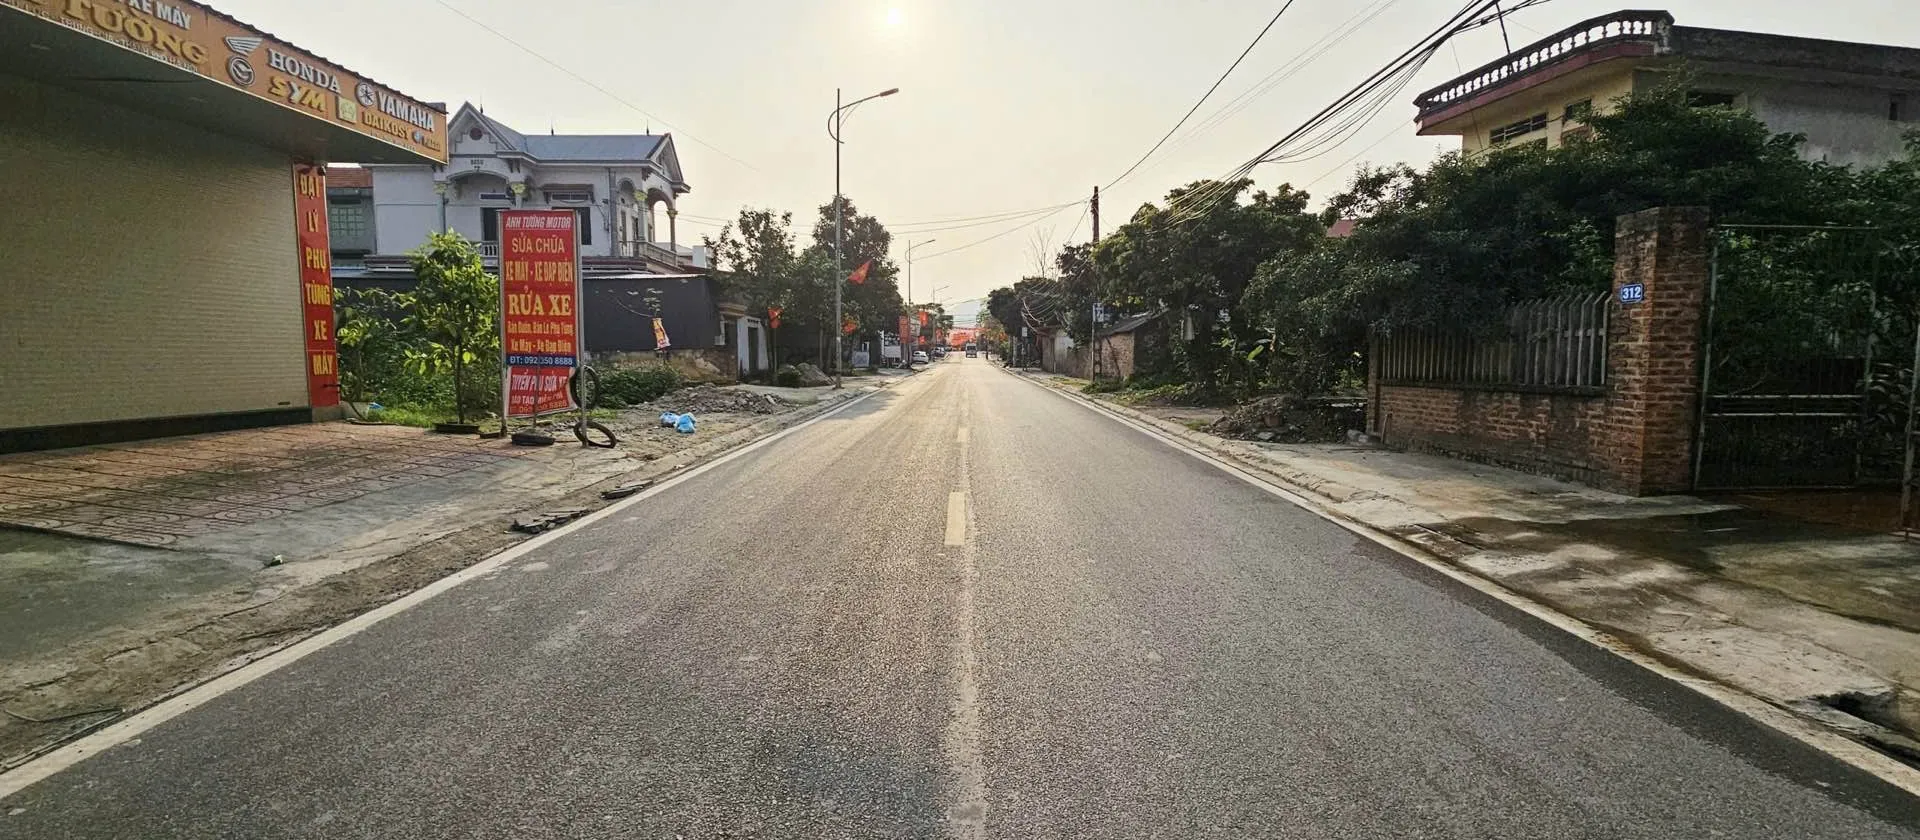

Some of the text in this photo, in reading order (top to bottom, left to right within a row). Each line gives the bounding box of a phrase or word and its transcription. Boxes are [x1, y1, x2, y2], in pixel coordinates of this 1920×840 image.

[155, 1, 192, 30] MÁY
[269, 48, 341, 94] HONDA
[269, 77, 327, 112] SYM
[376, 90, 434, 133] YAMAHA
[300, 173, 320, 200] ĐẠI
[307, 208, 319, 233] LÝ
[505, 215, 522, 228] ANH
[546, 215, 571, 228] MOTOR
[512, 231, 566, 254] SỬA CHỮA
[305, 246, 328, 273] PHỤ
[505, 260, 514, 281] XE
[514, 257, 528, 281] MÁY
[534, 260, 543, 282] XE
[305, 280, 331, 306] TÙNG
[508, 284, 572, 316] RỬA XE
[1622, 286, 1641, 300] 312
[313, 319, 328, 341] XE
[312, 350, 333, 376] MÁY
